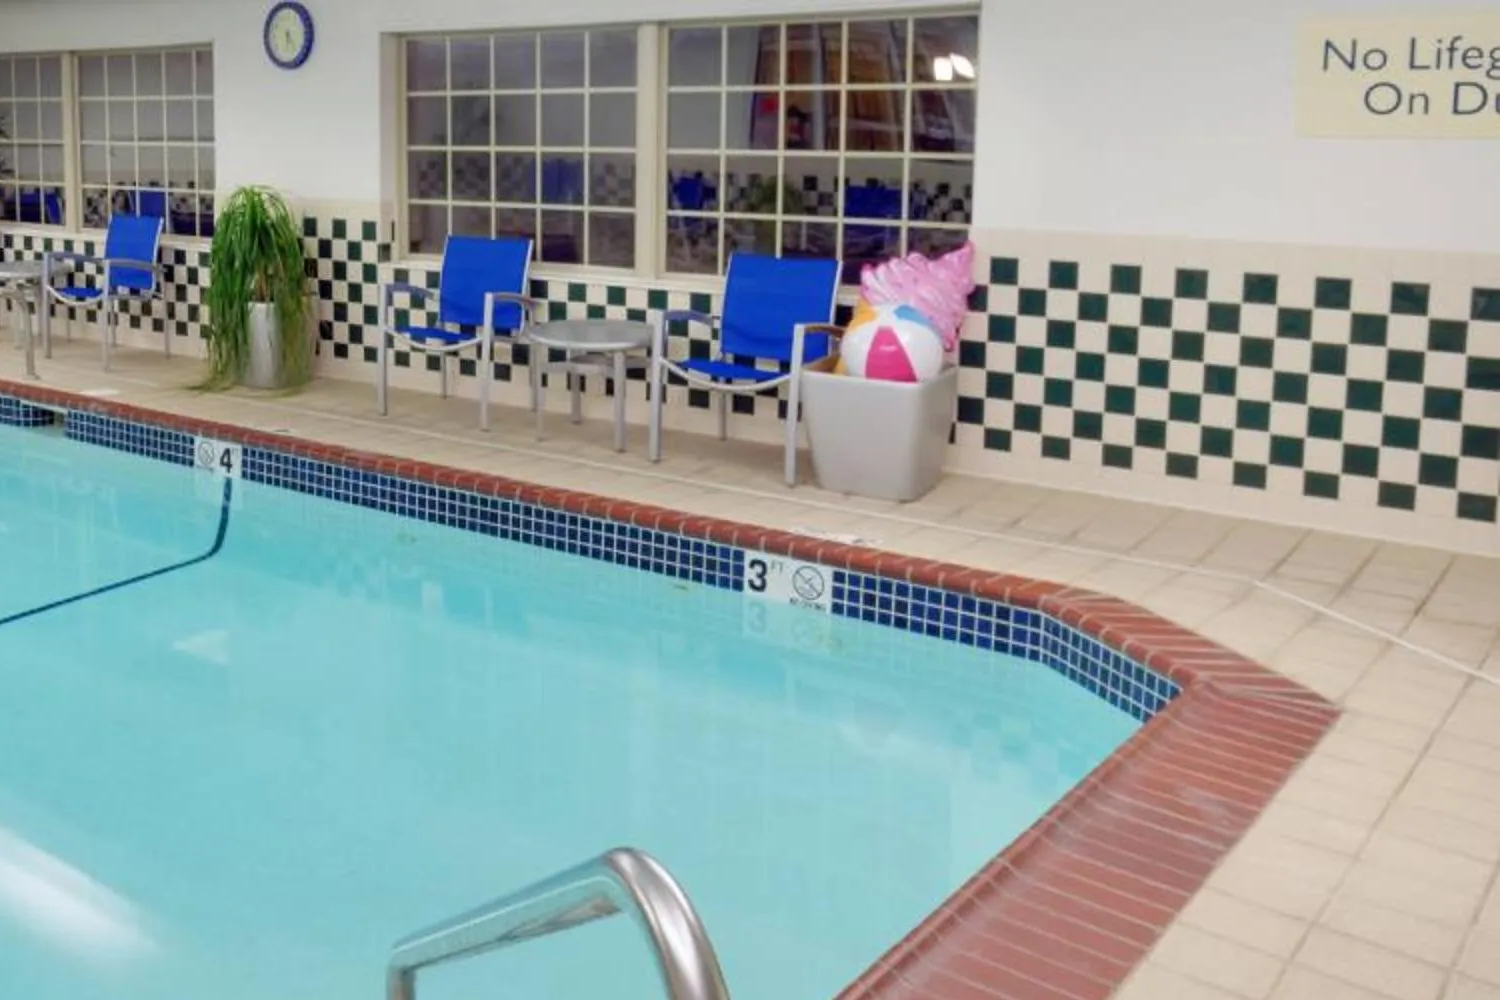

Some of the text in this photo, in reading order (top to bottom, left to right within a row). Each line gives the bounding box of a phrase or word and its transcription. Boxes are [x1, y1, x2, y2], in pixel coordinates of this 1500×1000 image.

[1322, 38, 1388, 72] No
[1363, 81, 1500, 115] On D
[220, 447, 233, 474] 4
[747, 558, 767, 592] 3
